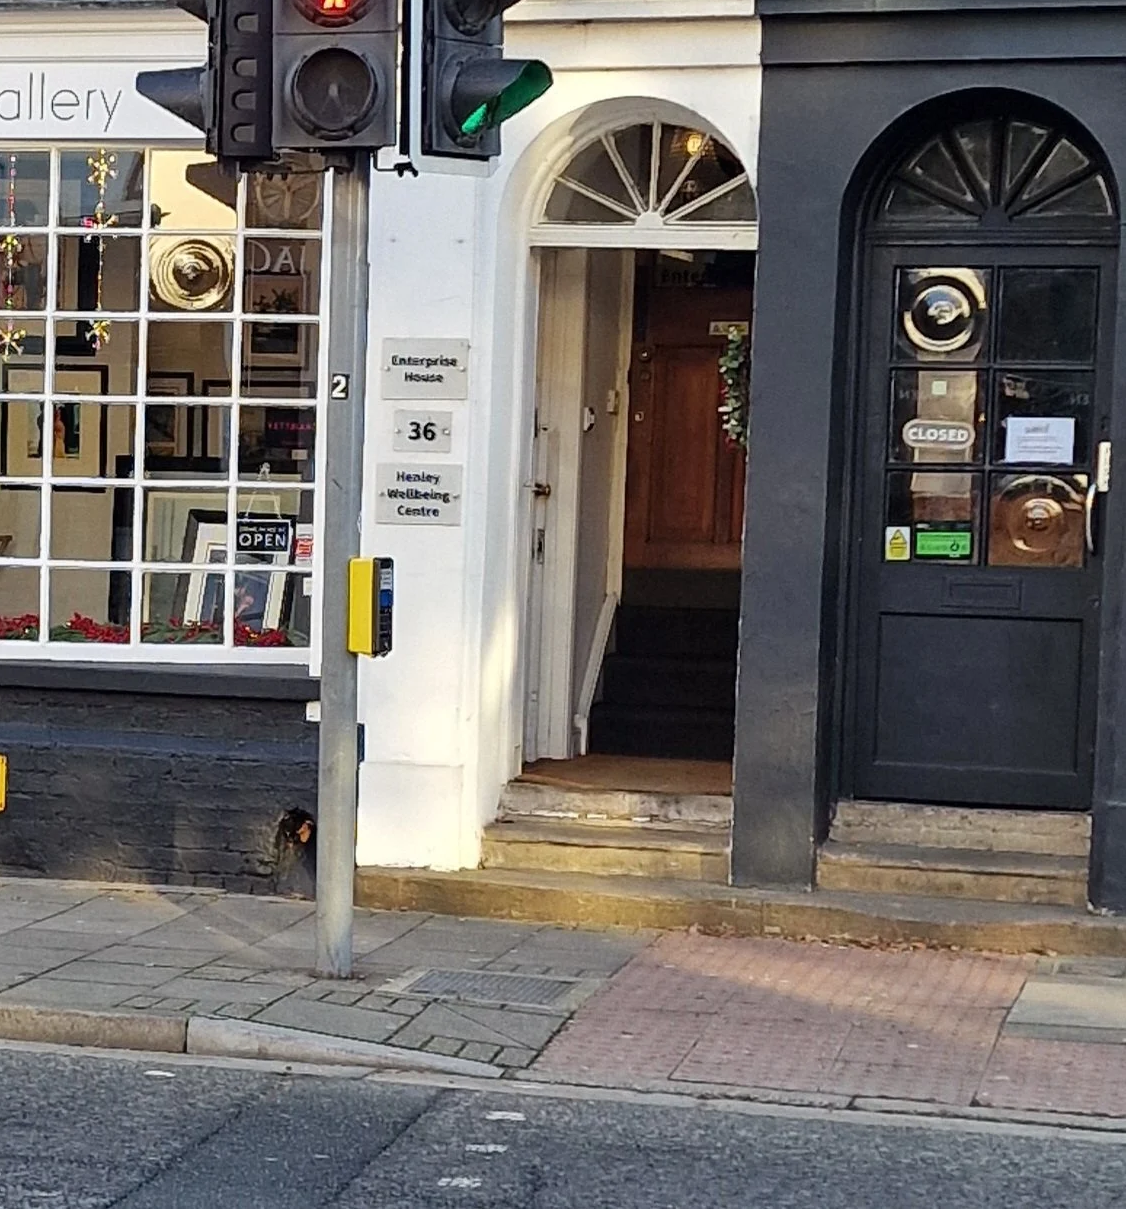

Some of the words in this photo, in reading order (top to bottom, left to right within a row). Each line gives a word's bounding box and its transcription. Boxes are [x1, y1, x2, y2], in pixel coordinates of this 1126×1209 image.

[391, 355, 458, 368] Enterprise
[404, 372, 444, 383] House
[331, 375, 347, 398] 2
[408, 421, 436, 441] 36
[908, 427, 968, 442] CLOSED
[396, 470, 440, 485] Henley
[387, 488, 451, 504] Wellbeing
[397, 505, 440, 517] Centre
[239, 533, 287, 547] OPEN
